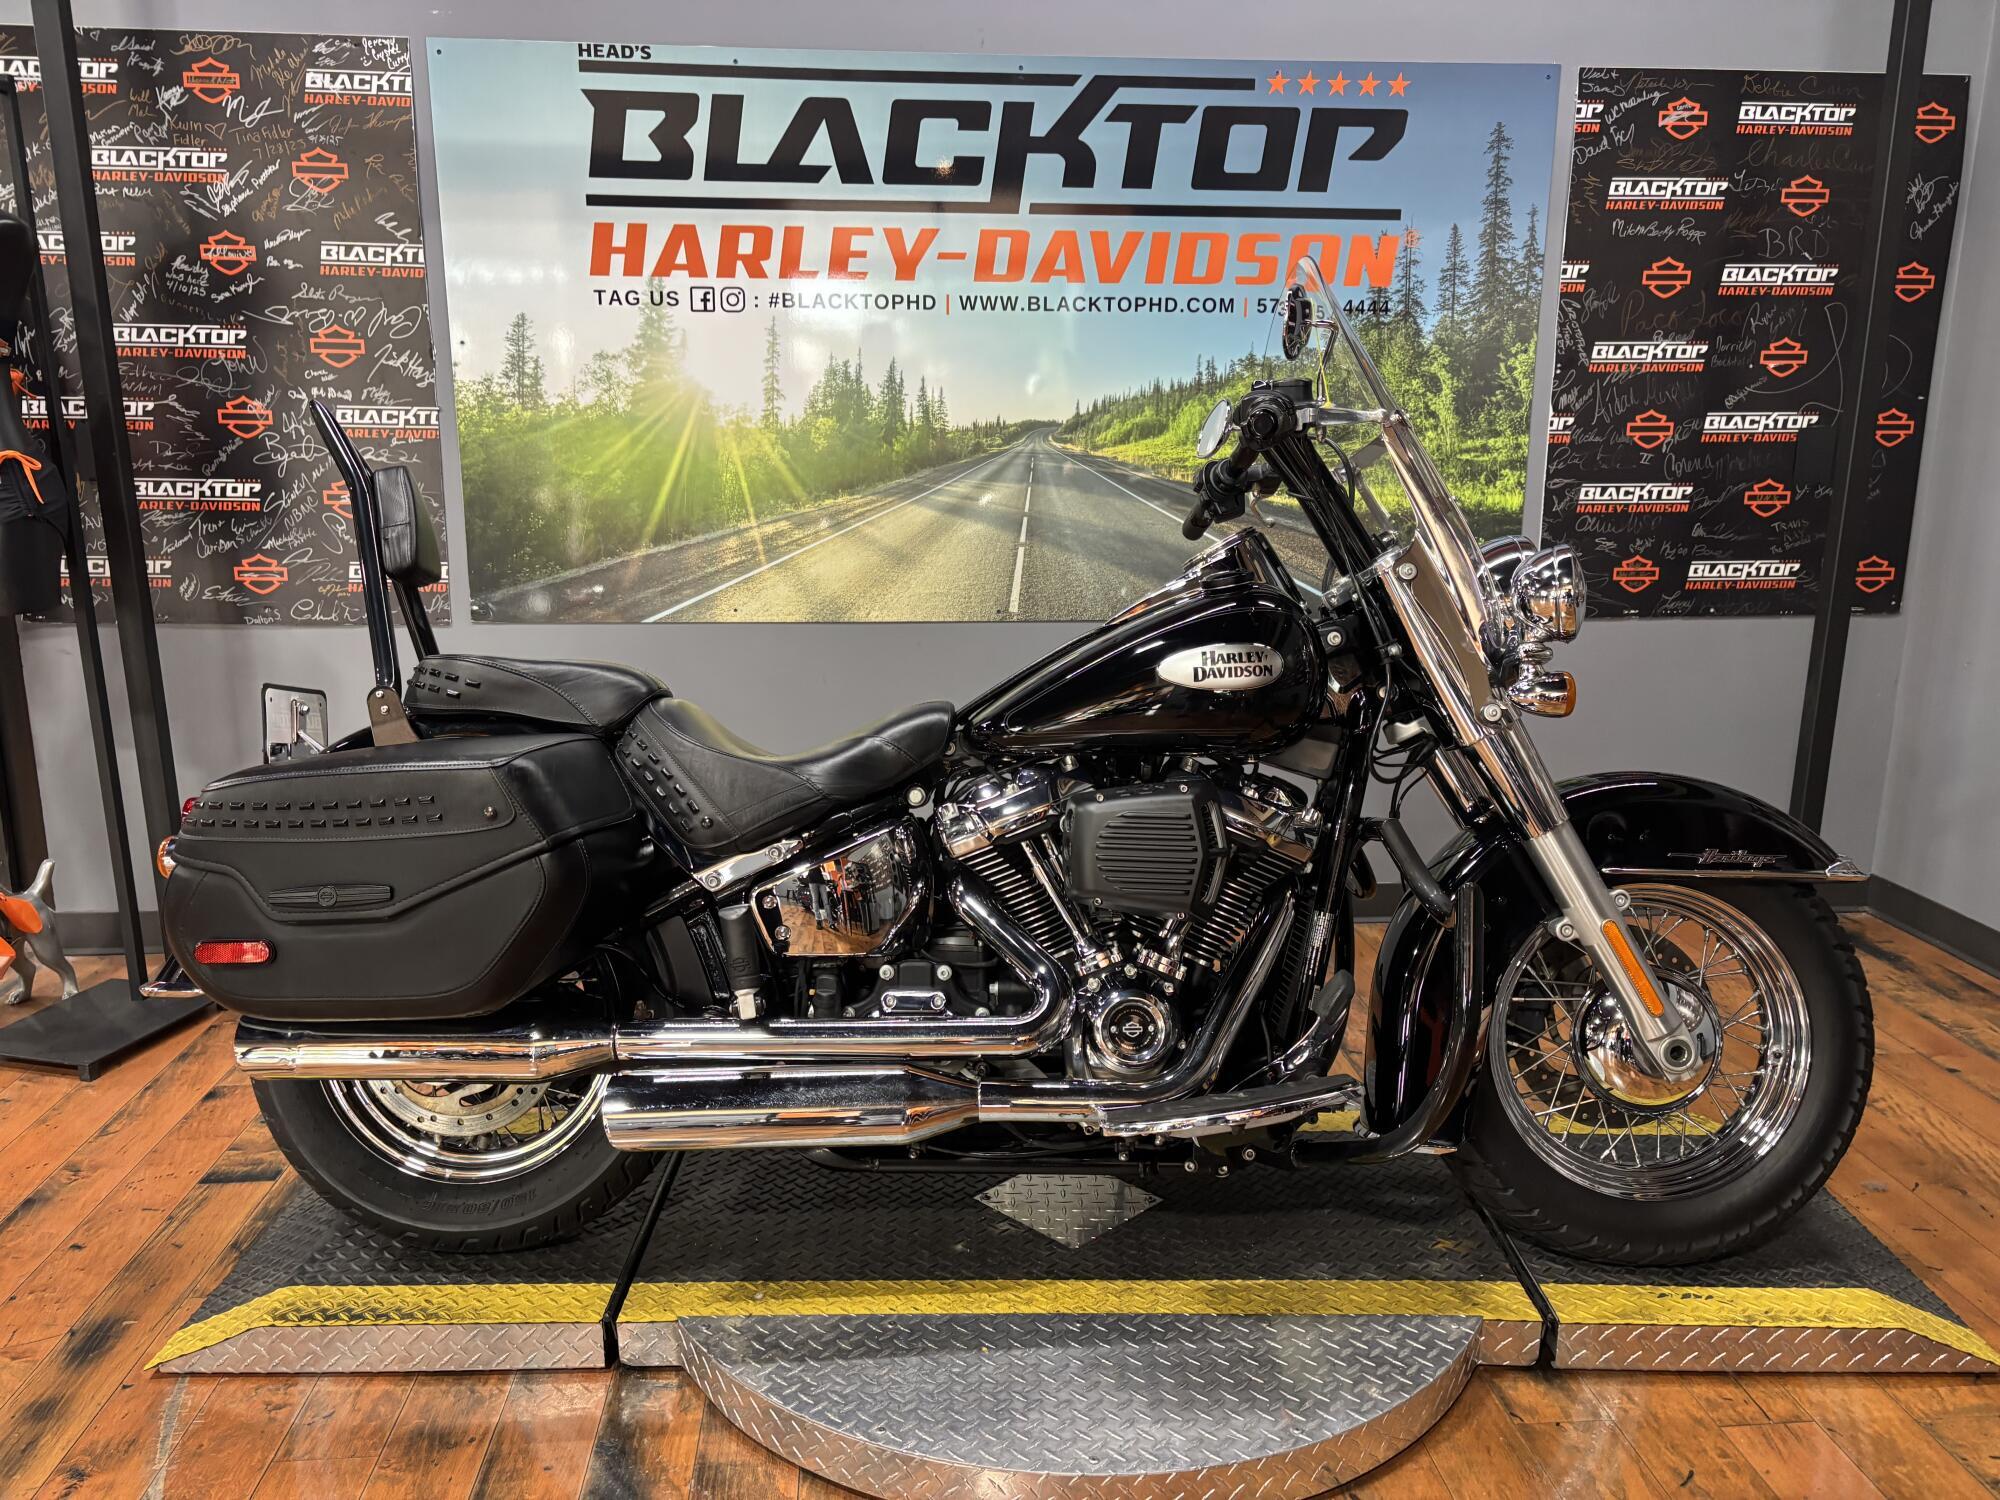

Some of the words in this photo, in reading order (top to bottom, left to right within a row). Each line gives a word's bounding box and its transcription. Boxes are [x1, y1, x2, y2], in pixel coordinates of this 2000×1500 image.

[577, 43, 652, 60] HEAD'S
[305, 71, 411, 94] BLACKT
[1739, 105, 1857, 124] BLACKTOP
[1736, 125, 1853, 136] HARLEY-DAVIDSON
[580, 76, 1409, 214] BLACKTOP
[92, 149, 228, 170] BLACKTOP
[92, 171, 229, 184] HARLEY-DAVIDSON
[1608, 180, 1729, 200] BLACKTOP
[1605, 200, 1725, 211] HARLEY-DAVIDSON
[589, 222, 1400, 288] HARLEY-DAVIDSON
[1721, 266, 1839, 286] BLACKTOP
[1717, 286, 1834, 296] HARLEY-DAVIDSON
[593, 290, 640, 307] TAG
[650, 290, 680, 307] US
[768, 292, 936, 311] #BLACKTOPHD
[959, 294, 1235, 314] WWW.BLACKTOPHD.COM
[114, 326, 247, 348] BLACKTOP
[1591, 344, 1709, 363] BLACKTOP
[1588, 363, 1705, 373] HARLEY-DAVIDSON
[1704, 413, 1820, 432] BLACKTOP
[345, 428, 440, 440] ARLEY-DAVID
[1700, 433, 1798, 443] HARLEY-DAVIDS
[1579, 486, 1694, 502] BLACKTOP
[138, 500, 261, 512] ARLEY-DAVIDSON
[1576, 503, 1689, 514] HARLEY-DAVIDSON
[1687, 563, 1801, 580] BLACKTOP
[1684, 580, 1797, 590] HARLEY-DAVIDSON
[1193, 664, 1273, 683] DAVIDSON
